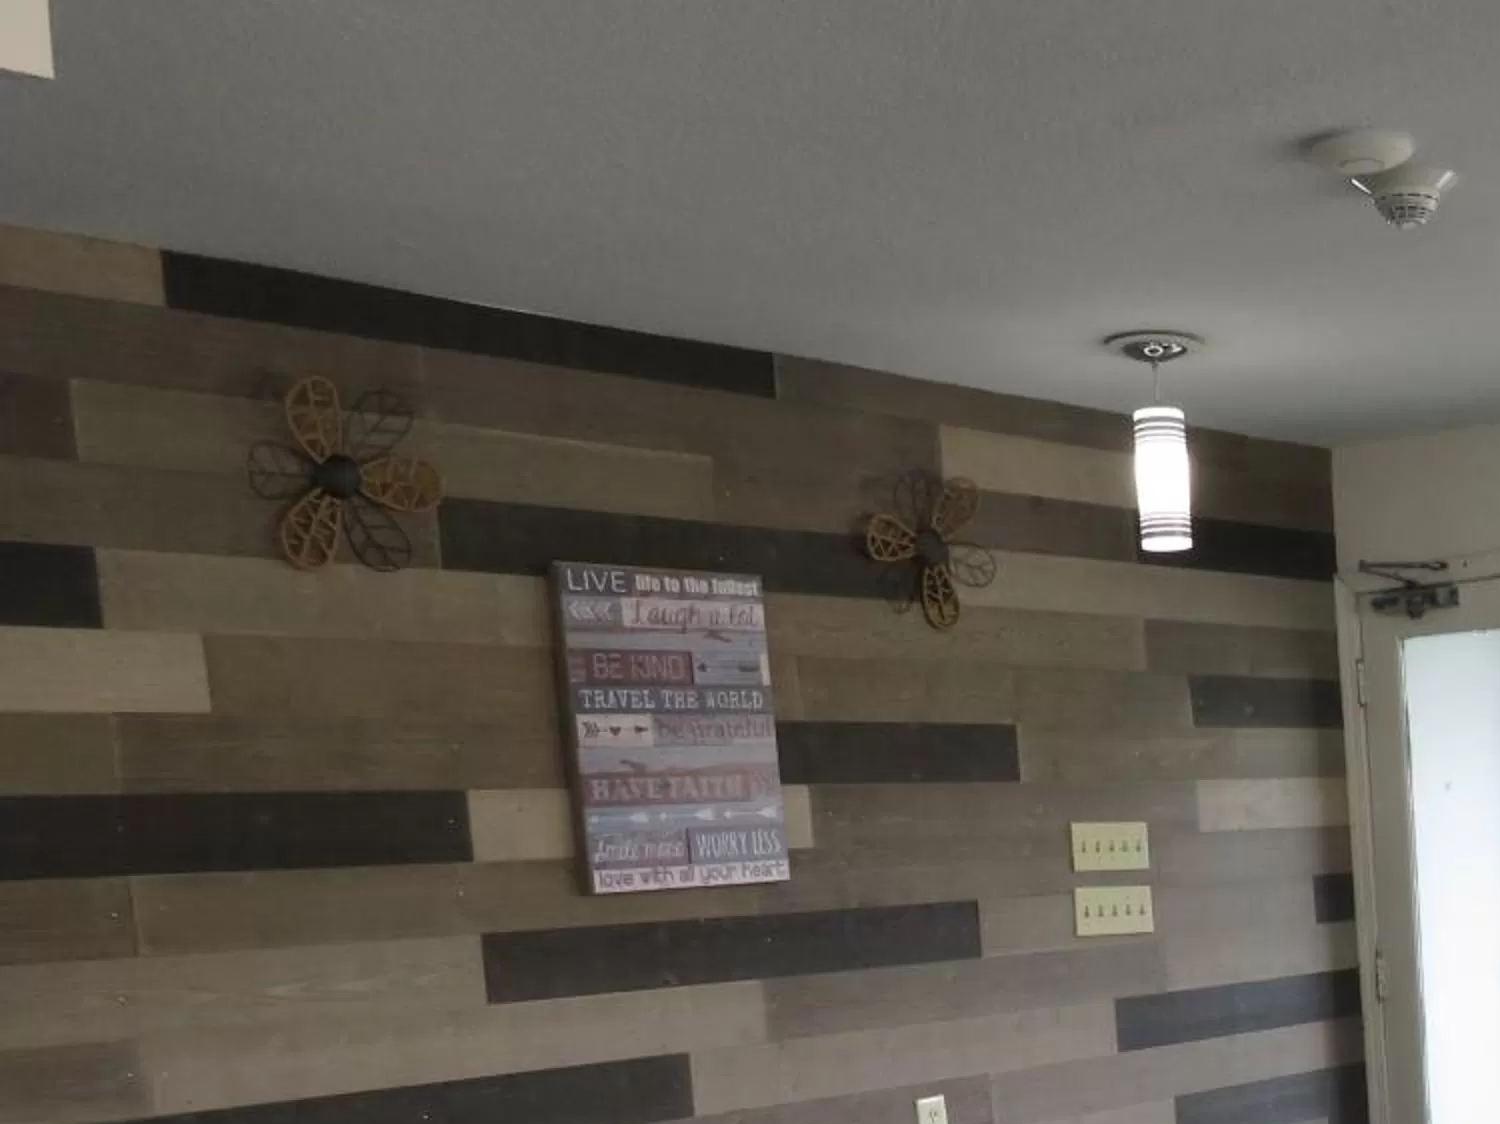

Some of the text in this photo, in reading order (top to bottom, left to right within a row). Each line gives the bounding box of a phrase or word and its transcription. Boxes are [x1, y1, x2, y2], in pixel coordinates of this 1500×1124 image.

[567, 567, 627, 593] LIVE
[634, 573, 661, 592] life
[662, 575, 681, 593] to
[683, 576, 709, 593] the
[592, 653, 686, 680] BE KIND
[578, 689, 764, 710] TRAVEL THE WORLD
[591, 774, 744, 801] HAVE FAITH
[695, 827, 783, 858] WORRY LESS
[701, 863, 739, 884] your
